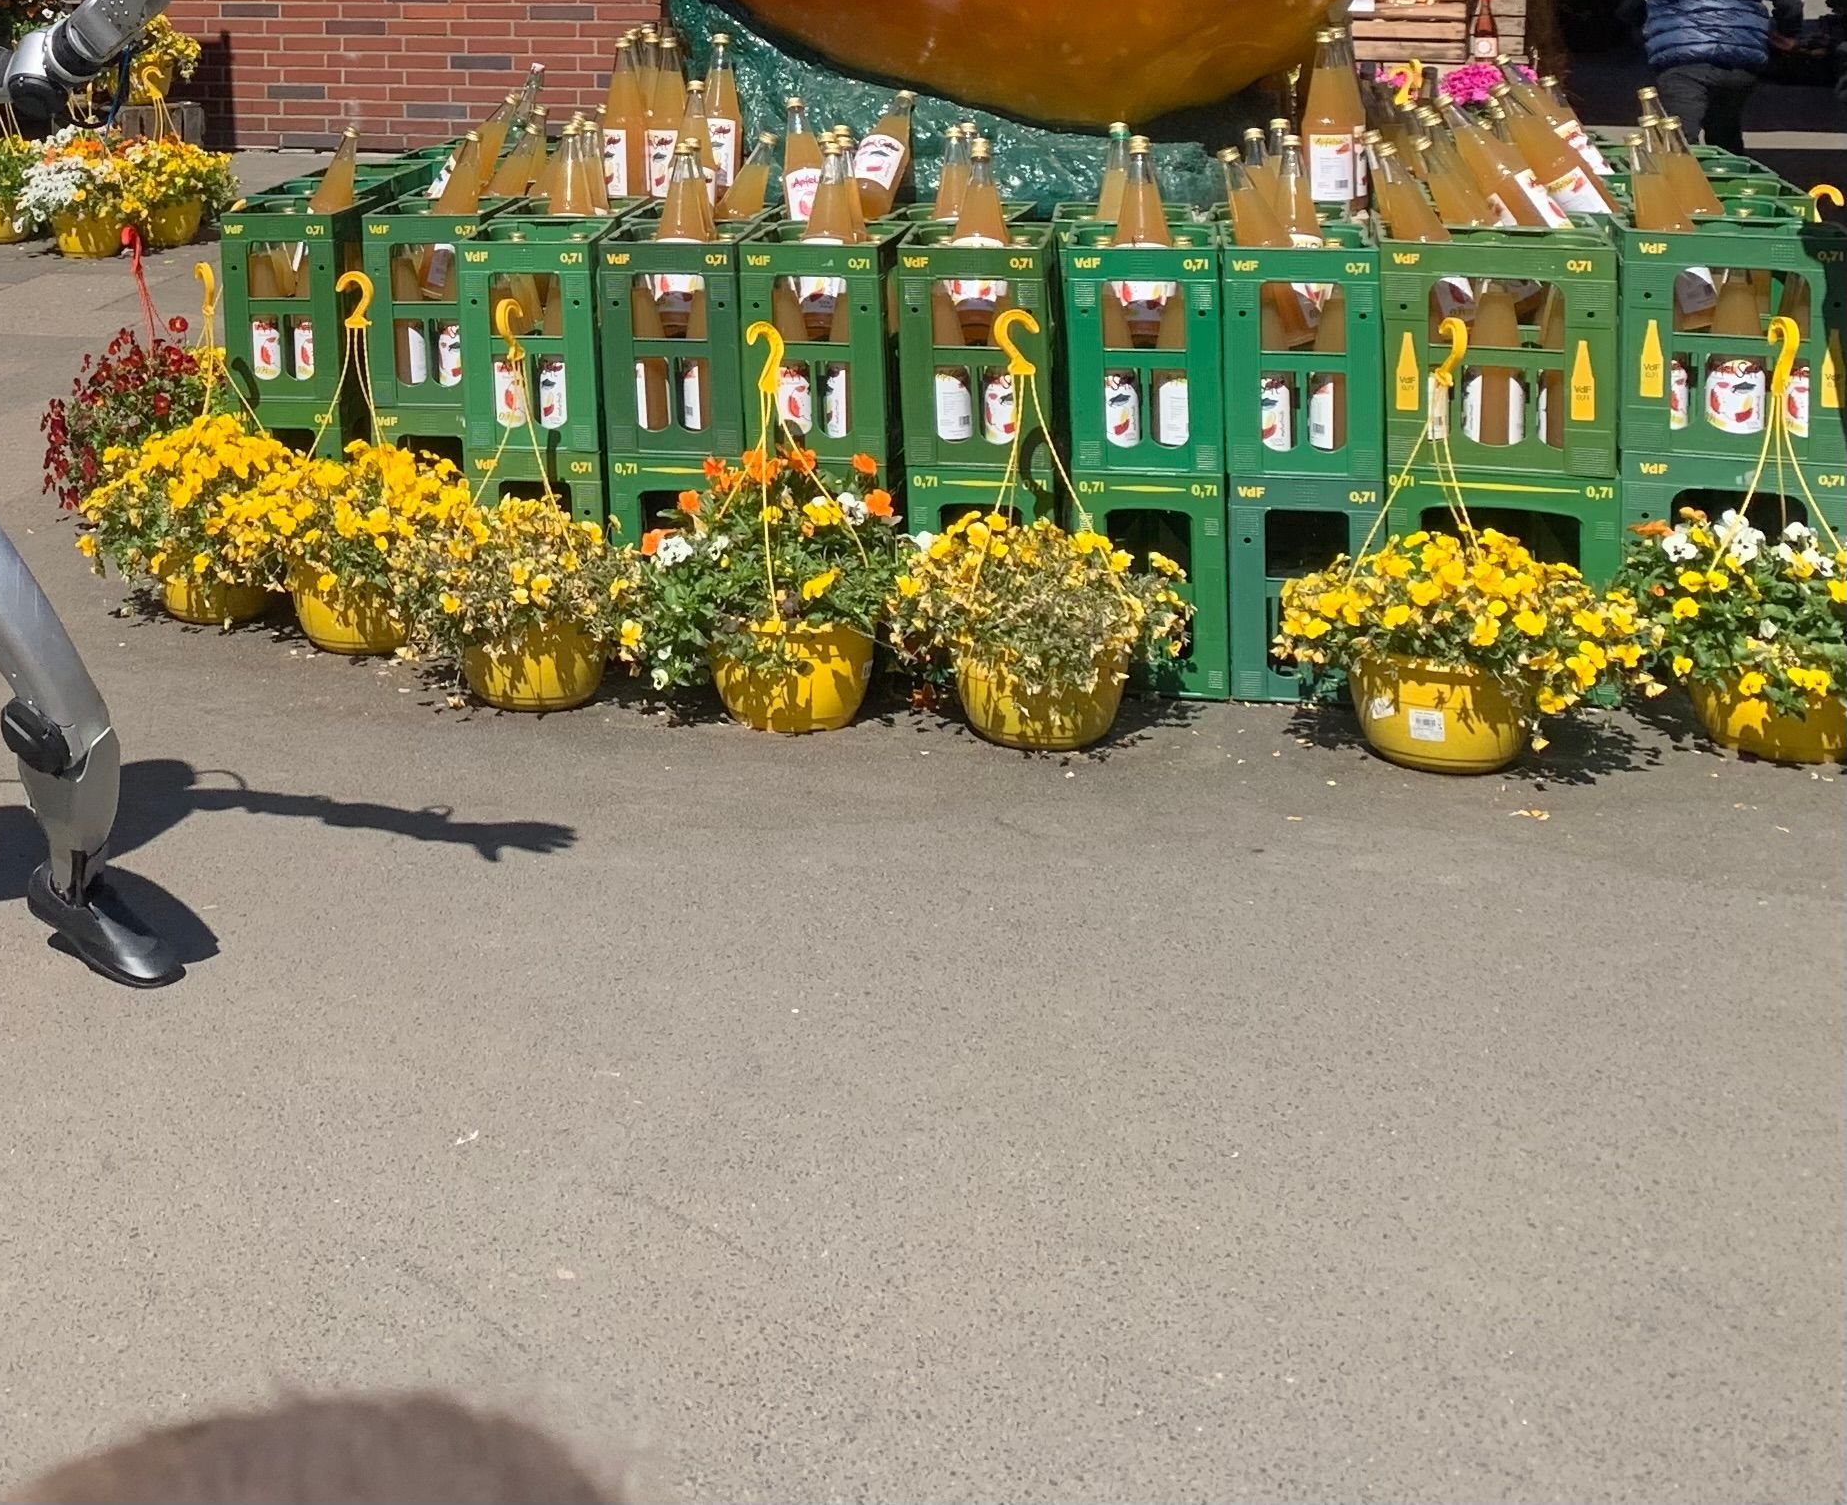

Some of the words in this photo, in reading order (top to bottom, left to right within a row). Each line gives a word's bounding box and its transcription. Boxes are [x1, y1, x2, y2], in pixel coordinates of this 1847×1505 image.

[224, 225, 244, 234] VdF
[306, 225, 324, 236] 0,7l
[369, 225, 390, 235] VdF
[455, 225, 477, 236] 0,7l
[465, 252, 488, 263] VdF
[560, 252, 583, 265] 0,7l
[1639, 242, 1668, 254] VdF
[1817, 251, 1844, 263] 0,7l
[606, 254, 630, 265] VdF
[705, 254, 727, 266] 0,7l
[747, 255, 771, 266] VdF
[848, 258, 870, 270] 0,7l
[903, 257, 929, 268] VdF
[1010, 258, 1033, 270] 0,7l
[1074, 257, 1101, 269] VdF
[1183, 259, 1209, 271] 0,7l
[1393, 253, 1420, 265] VdF
[1567, 260, 1592, 273] 0,7l
[1232, 260, 1259, 271] VdF
[1345, 263, 1369, 275] 0,7l
[1574, 386, 1592, 394] VdF
[377, 417, 397, 427] VdF
[474, 459, 498, 470] VdF
[571, 462, 592, 473] 0,7l
[614, 463, 637, 475] 0,7l
[1640, 463, 1668, 474] VdF
[1818, 475, 1845, 487] 0,7l
[913, 476, 938, 489] 0,7l
[1079, 481, 1104, 494] 0,7l
[1191, 484, 1217, 497] 0,7l
[1237, 486, 1265, 498] VdF
[1349, 491, 1376, 505] 0,7l
[1586, 486, 1613, 500] 0,7l
